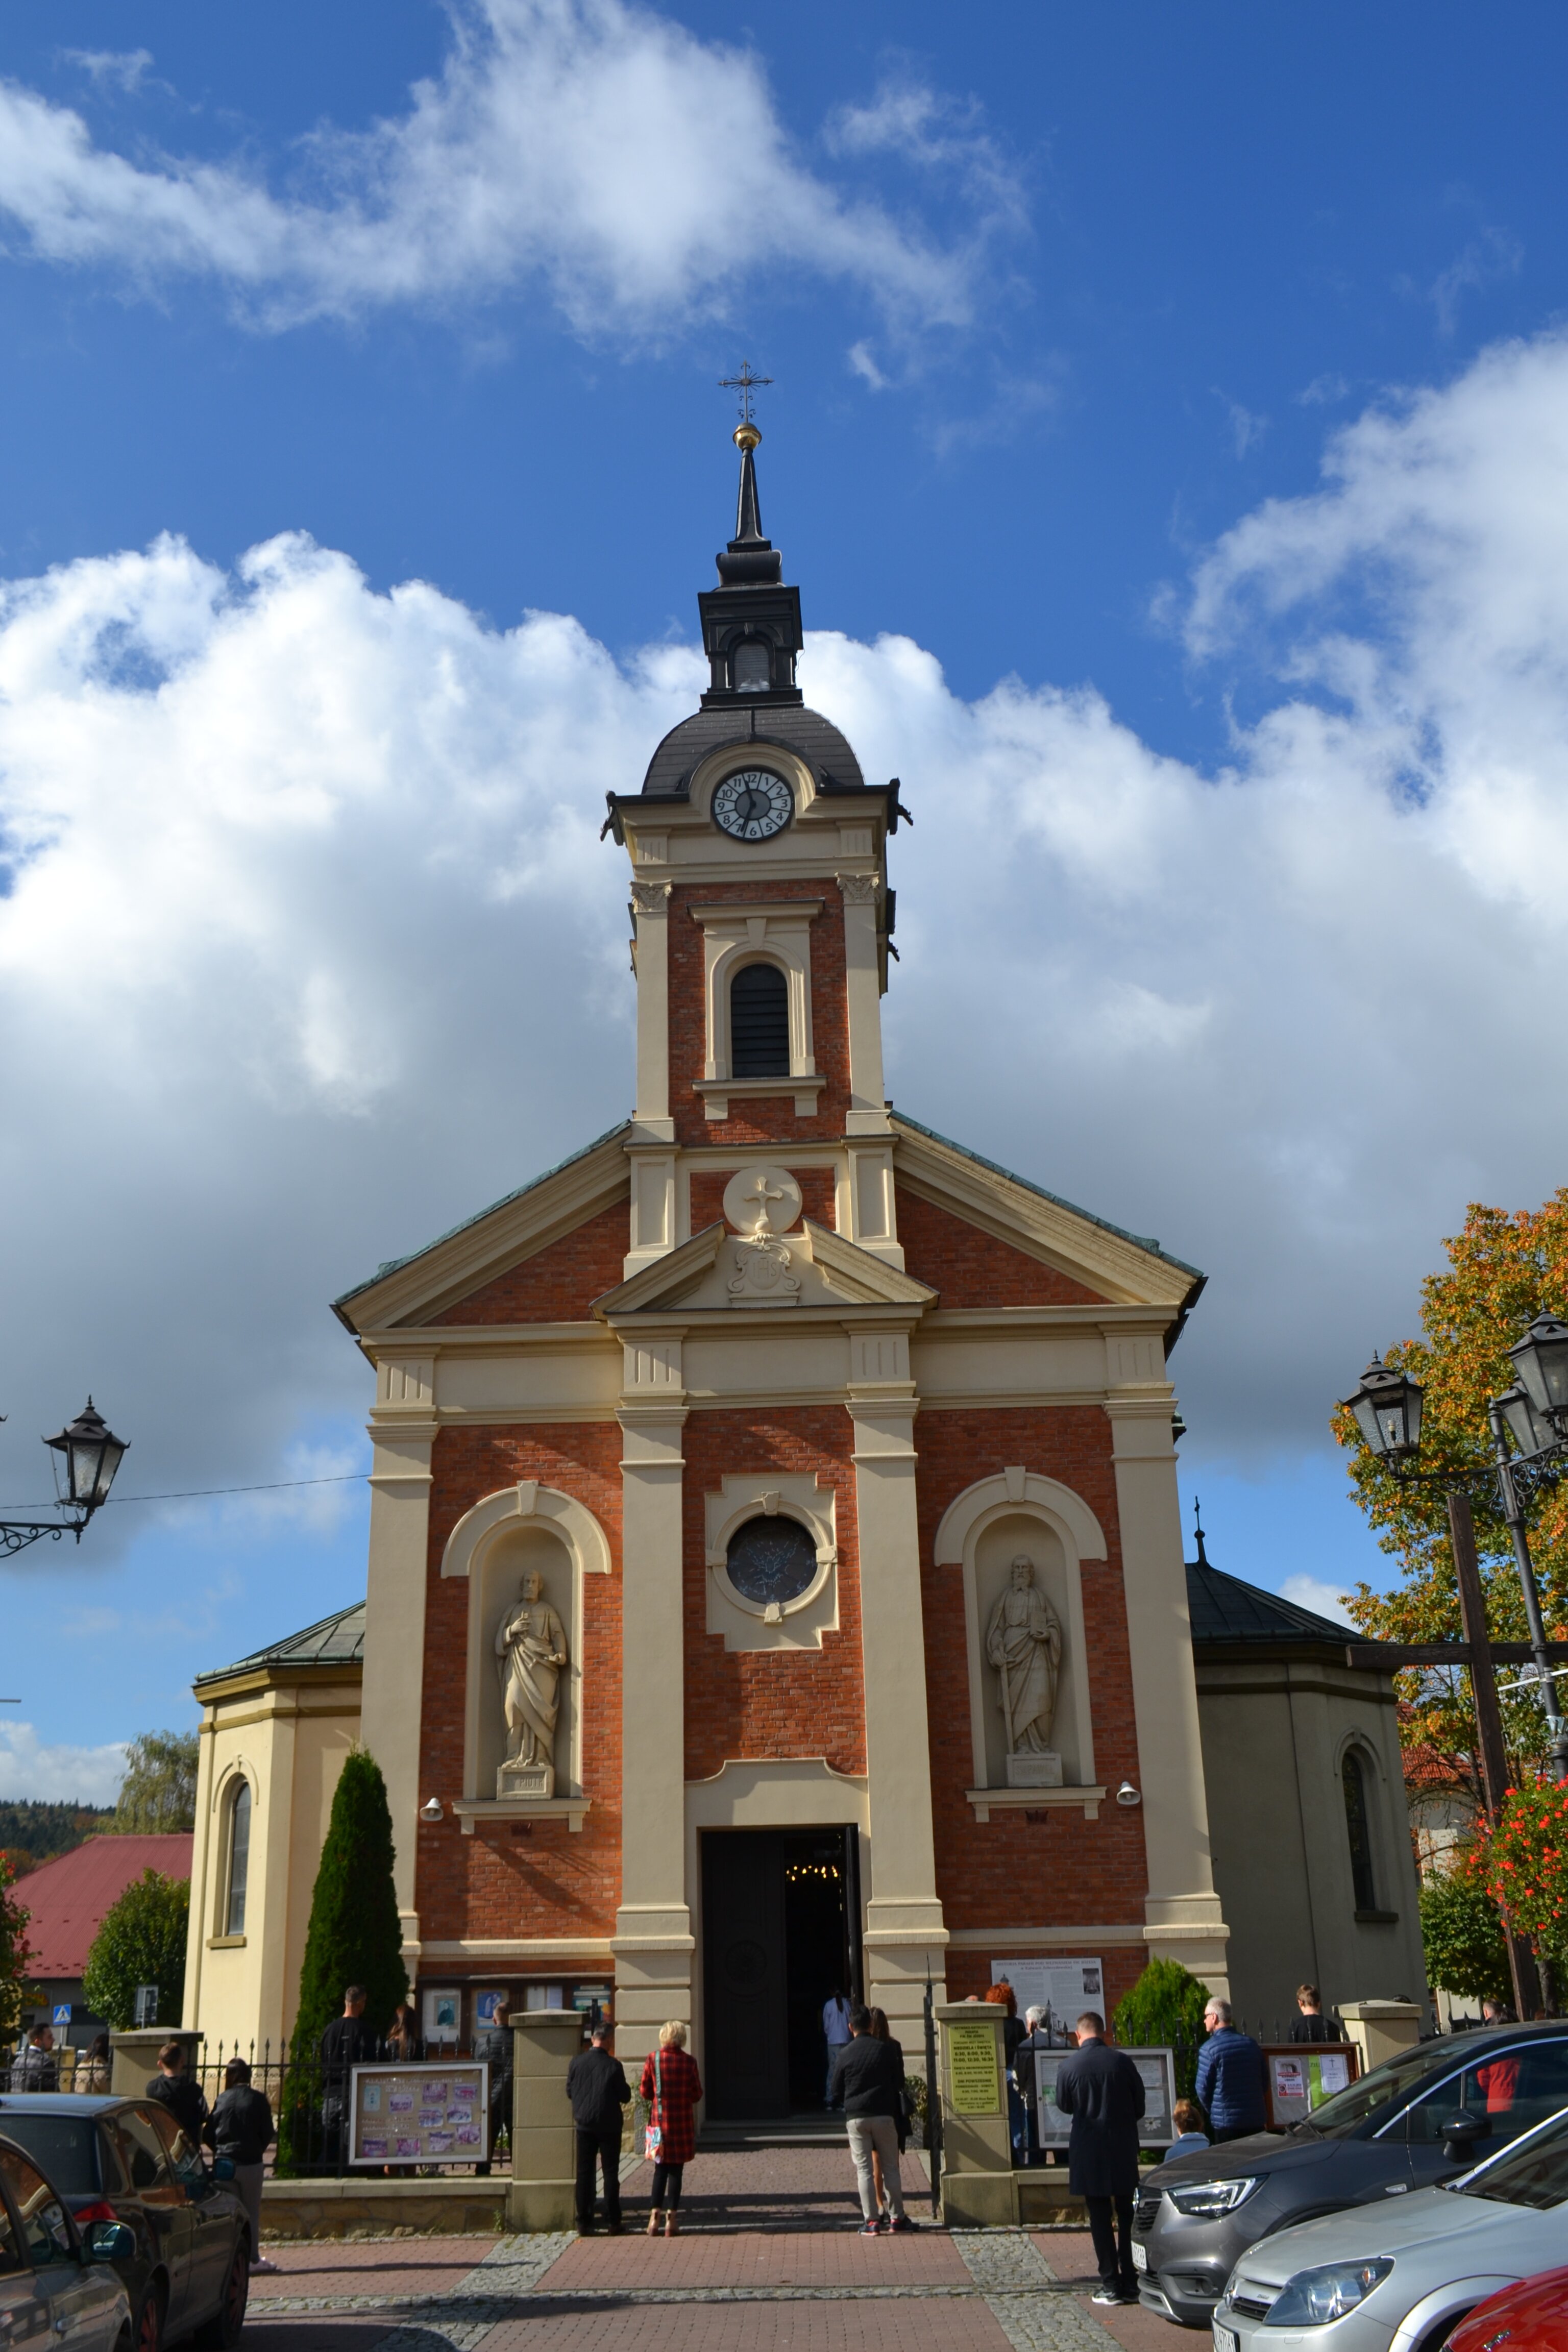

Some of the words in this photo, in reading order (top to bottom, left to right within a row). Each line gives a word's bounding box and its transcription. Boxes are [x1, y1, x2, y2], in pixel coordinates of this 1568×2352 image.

[733, 778, 741, 787] 11
[747, 774, 757, 783] 12
[765, 777, 769, 786] 1
[722, 789, 732, 798] 10
[776, 787, 783, 795] 2
[718, 802, 725, 811] 9
[781, 799, 788, 808] 3
[723, 815, 730, 824] 8
[776, 812, 783, 821] 4
[736, 824, 743, 832] 7
[750, 827, 756, 836] 6
[766, 822, 773, 832] 5
[753, 1258, 777, 1279] IHS
[520, 1777, 544, 1787] PIOTR
